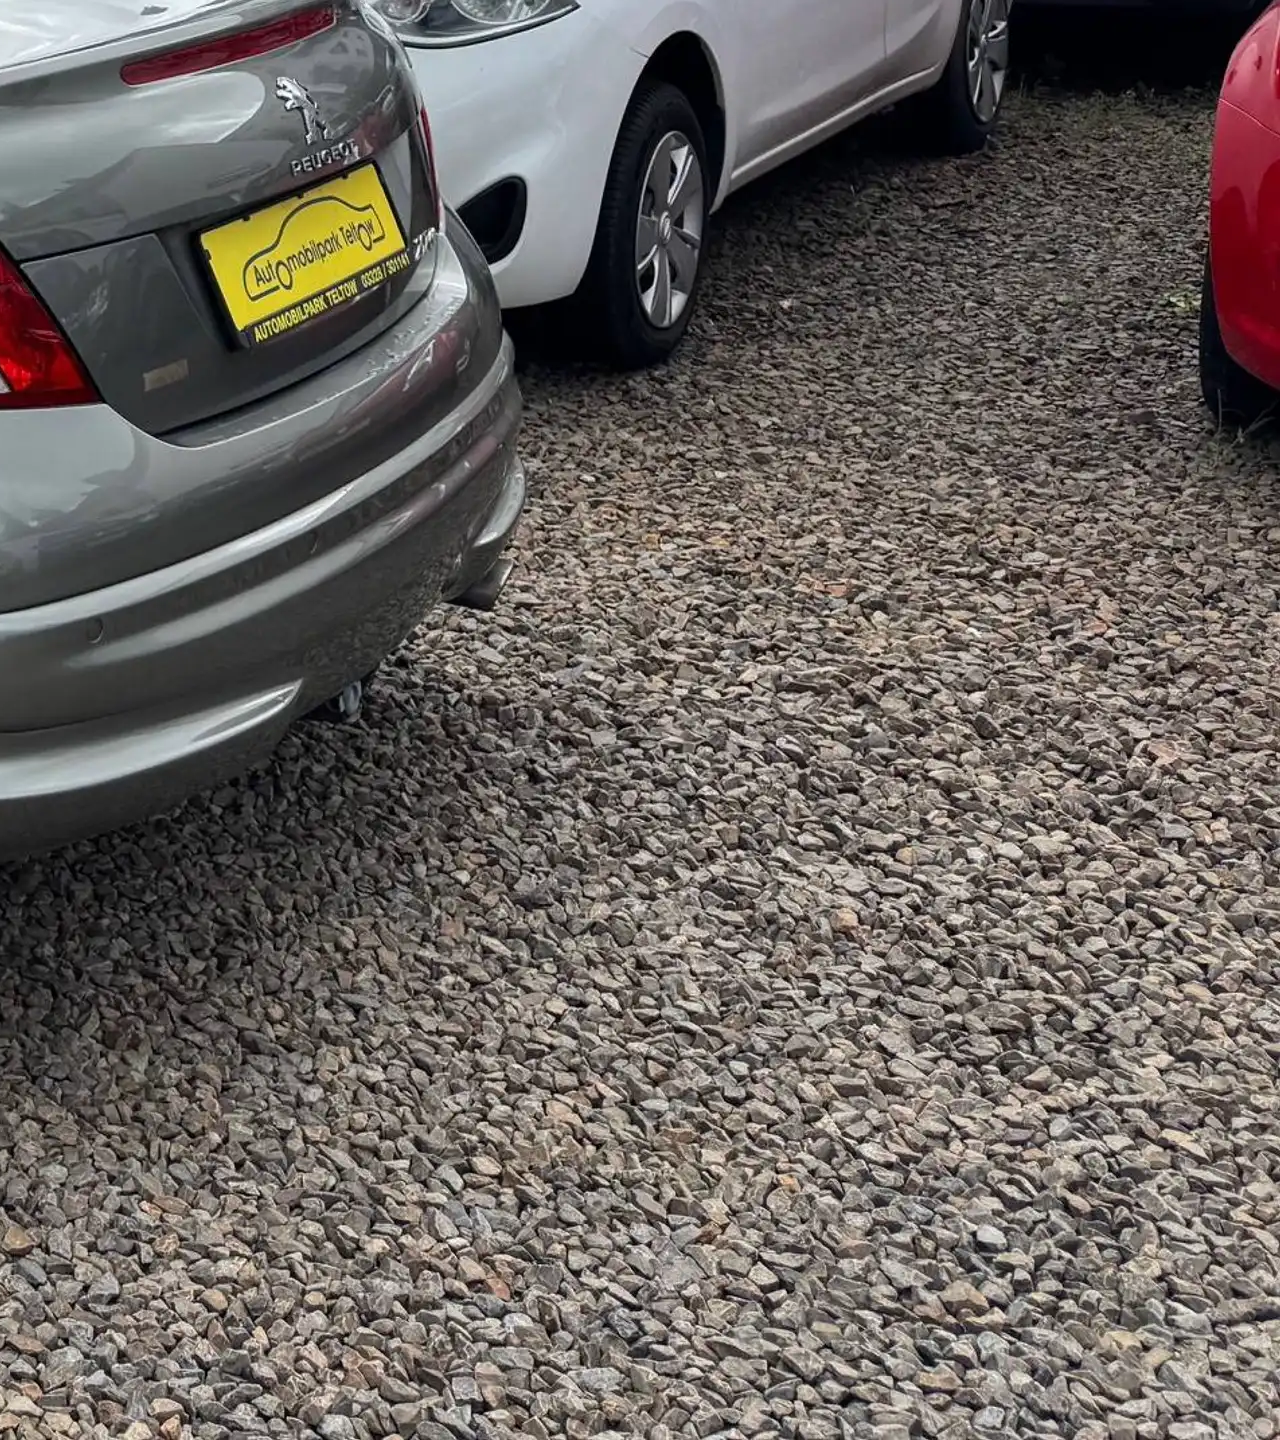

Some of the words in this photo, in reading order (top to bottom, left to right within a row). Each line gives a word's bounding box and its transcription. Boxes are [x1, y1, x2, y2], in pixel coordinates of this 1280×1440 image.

[291, 139, 360, 176] PEUGEOT
[253, 232, 343, 290] Automobilpark
[254, 295, 326, 342] AUTOMOBILPARK
[325, 278, 358, 309] TELTOW
